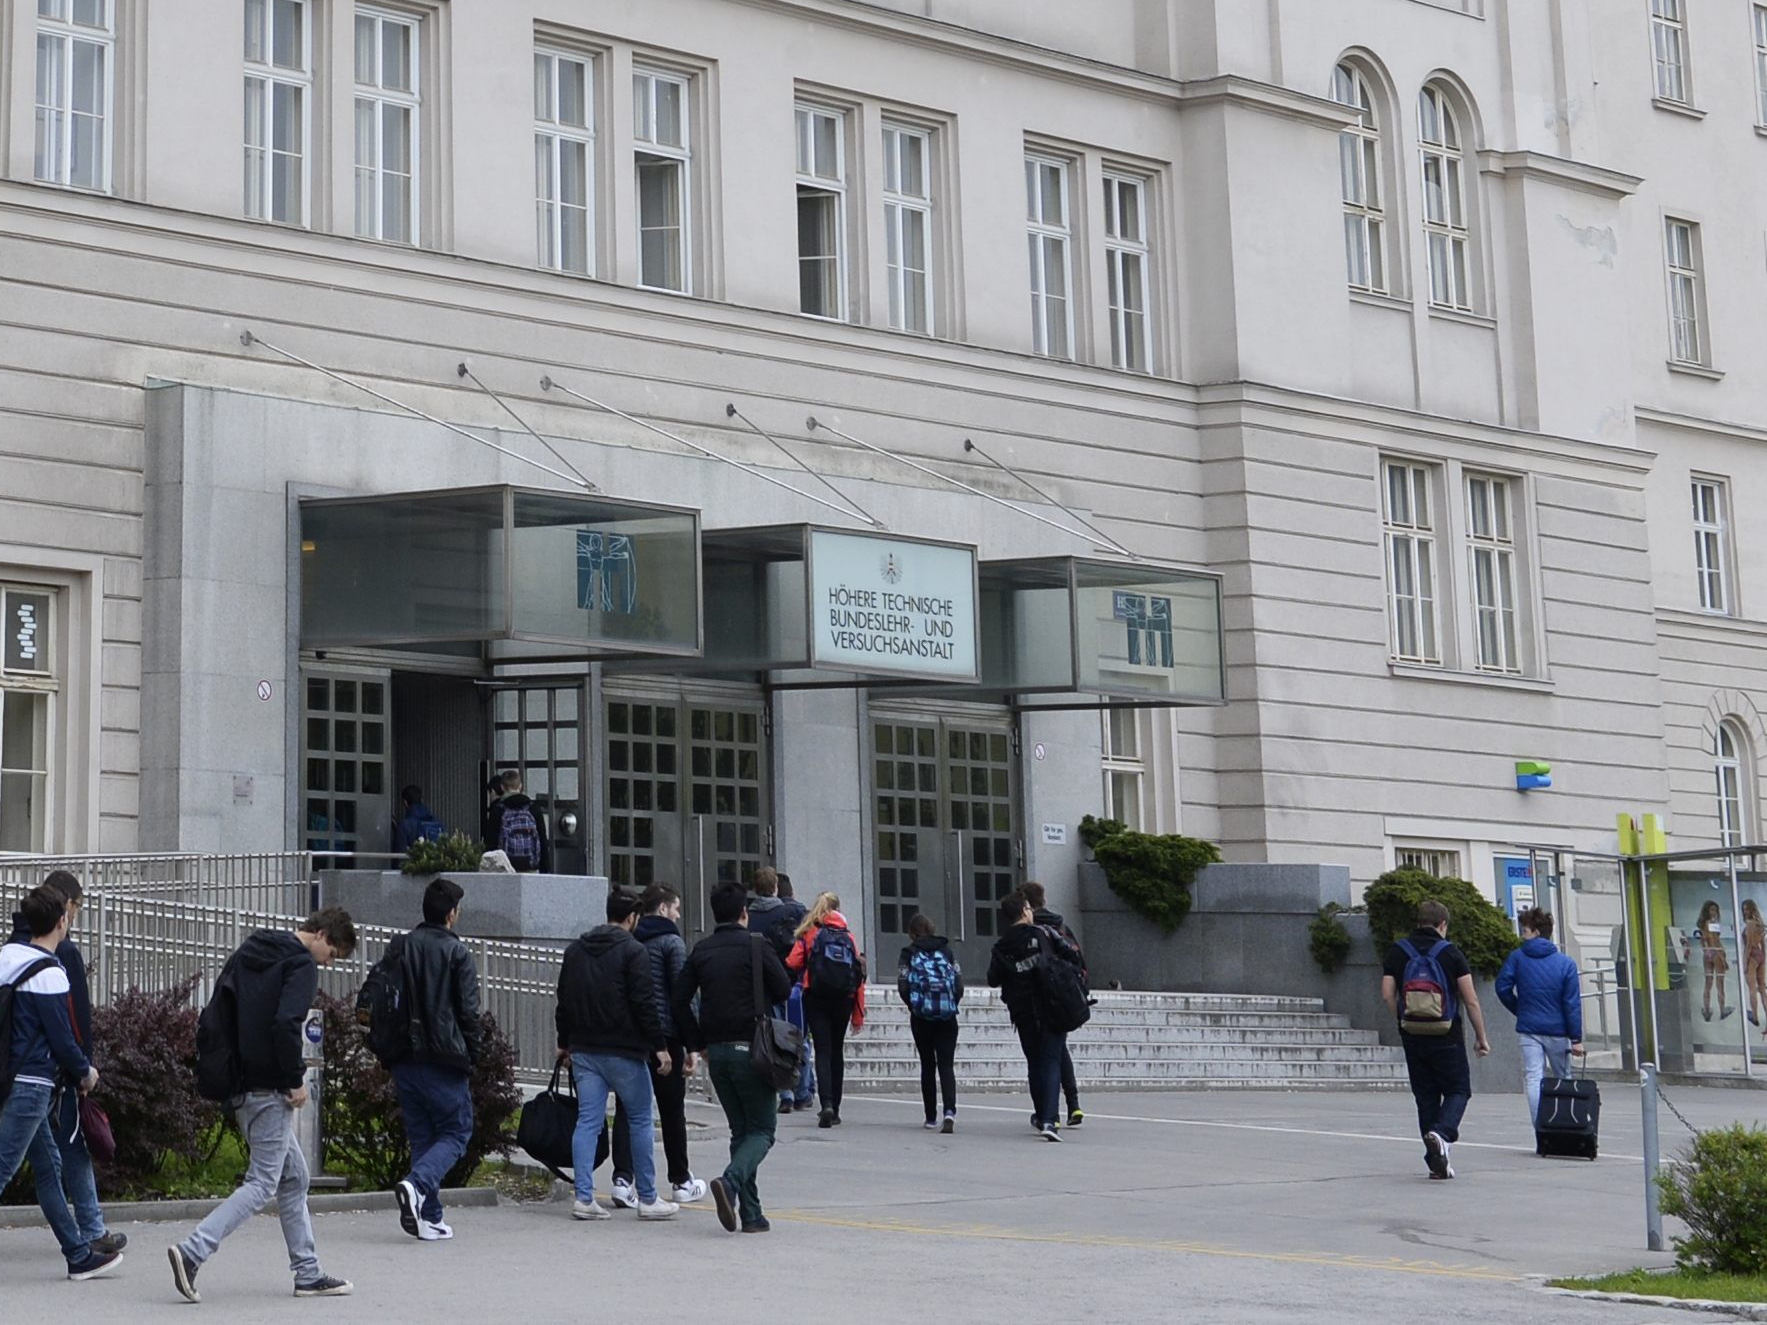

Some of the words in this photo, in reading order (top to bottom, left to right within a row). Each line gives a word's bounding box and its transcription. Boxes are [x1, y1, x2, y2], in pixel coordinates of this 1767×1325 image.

[829, 583, 877, 609] HÖHERE
[882, 592, 953, 617] TECHNISCHE
[830, 609, 915, 634] BUNDESLEHR-
[925, 619, 954, 638] UND
[831, 630, 954, 659] VERSUCHSANSTALT
